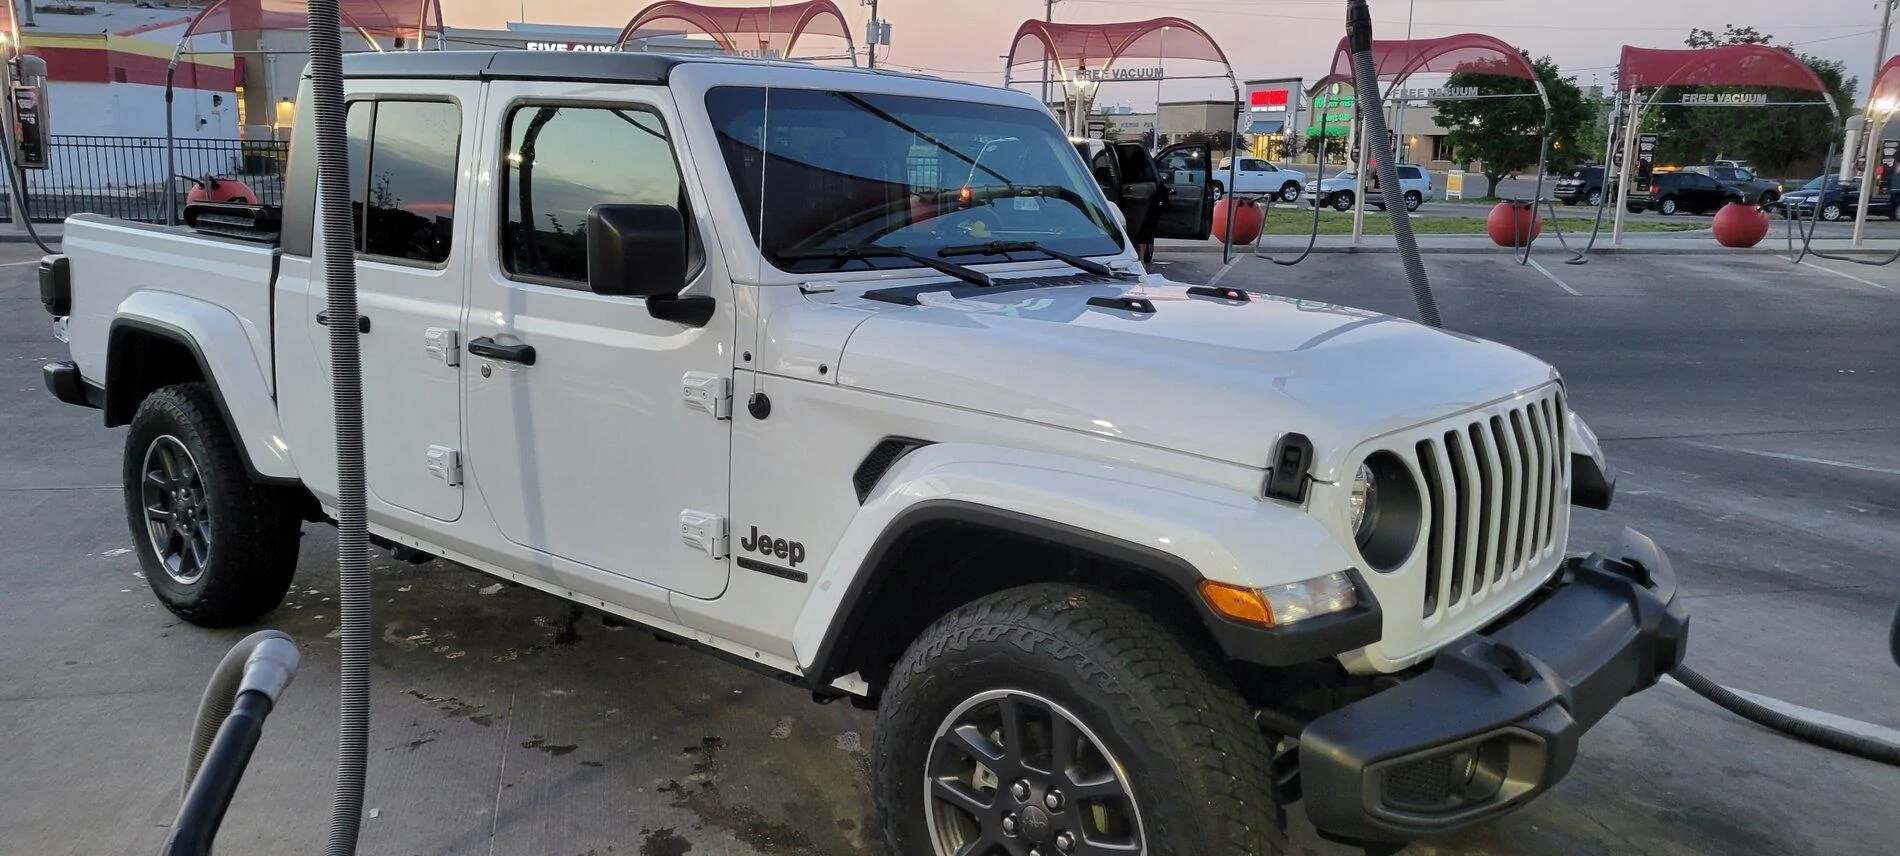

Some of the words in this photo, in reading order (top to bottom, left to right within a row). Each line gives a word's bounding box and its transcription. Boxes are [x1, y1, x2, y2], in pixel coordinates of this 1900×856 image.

[1075, 69, 1109, 80] FREE
[1112, 67, 1164, 79] VACUUM
[1393, 88, 1425, 99] FREE
[1428, 86, 1479, 98] VACUUM
[1682, 93, 1715, 104] FREE
[1717, 93, 1767, 104] VACUUM
[741, 525, 805, 567] Jeep
